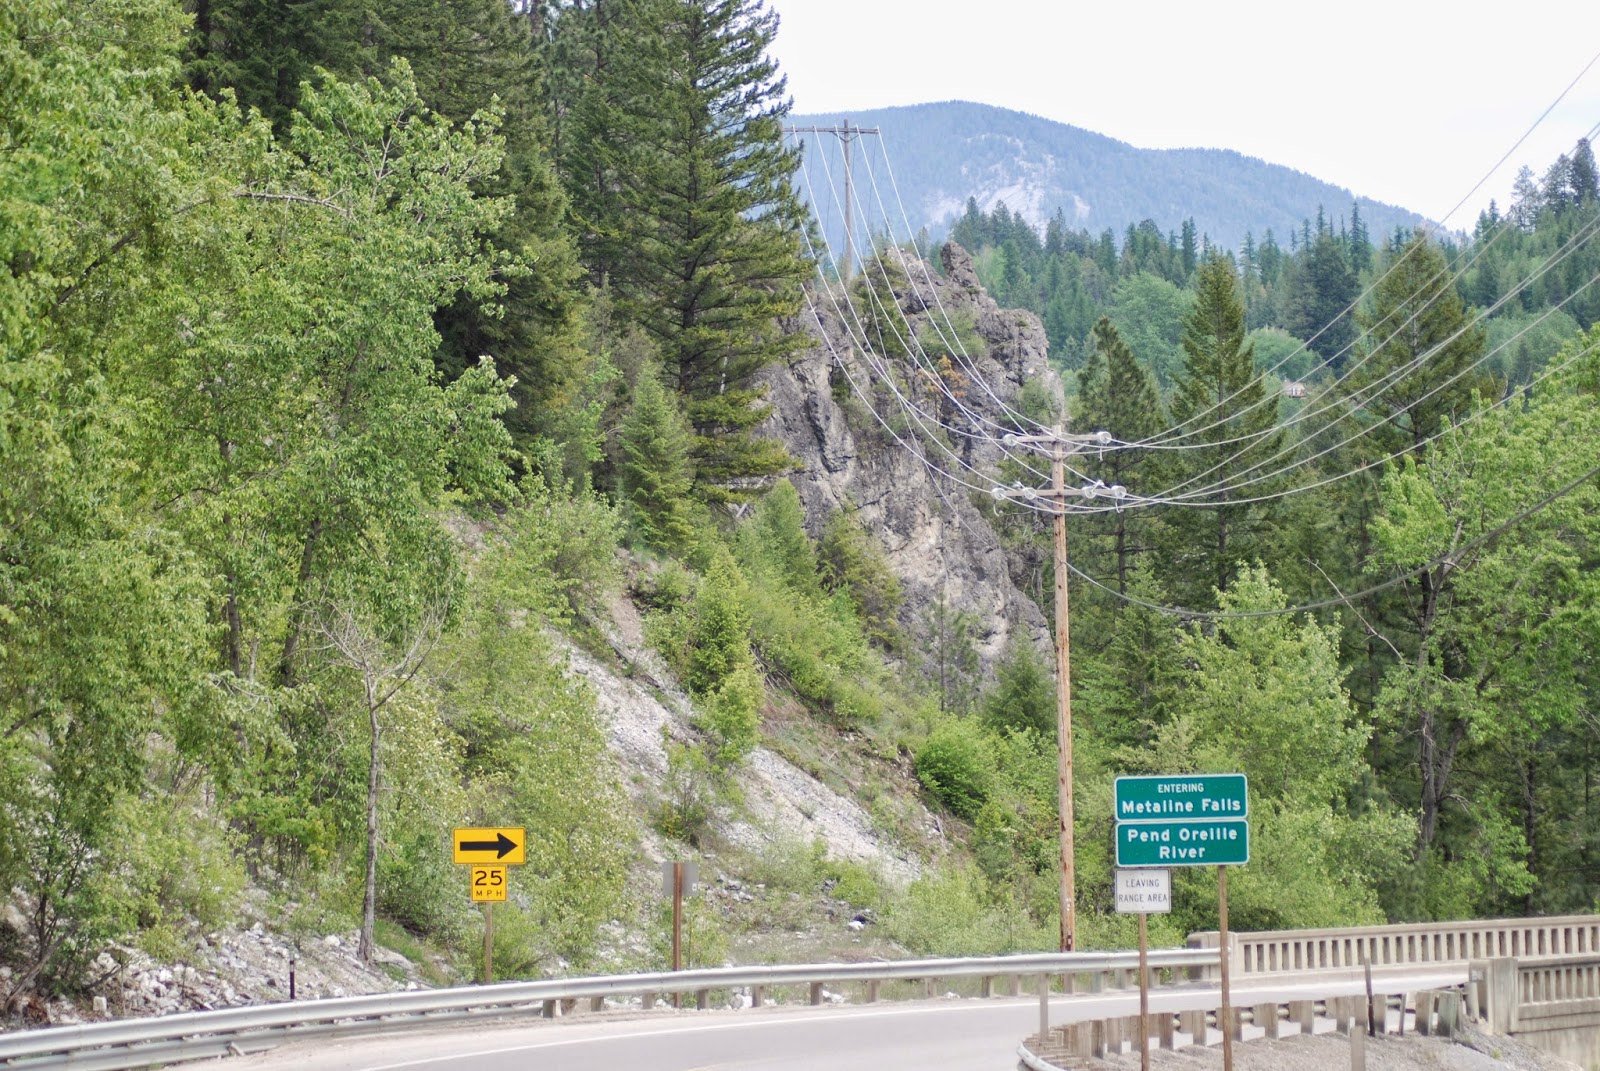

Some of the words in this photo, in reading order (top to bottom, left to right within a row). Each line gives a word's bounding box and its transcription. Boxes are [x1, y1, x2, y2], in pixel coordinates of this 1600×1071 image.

[1158, 783, 1204, 793] ENTERING
[1122, 800, 1194, 814] Metaline
[1202, 798, 1241, 812] Falls
[1128, 828, 1170, 842] Pend
[1179, 828, 1238, 841] Oreille
[1160, 846, 1206, 859] River
[474, 870, 502, 886] 25
[1126, 879, 1160, 888] LEAVING
[1118, 894, 1144, 902] RANGE
[1147, 893, 1168, 902] AREA
